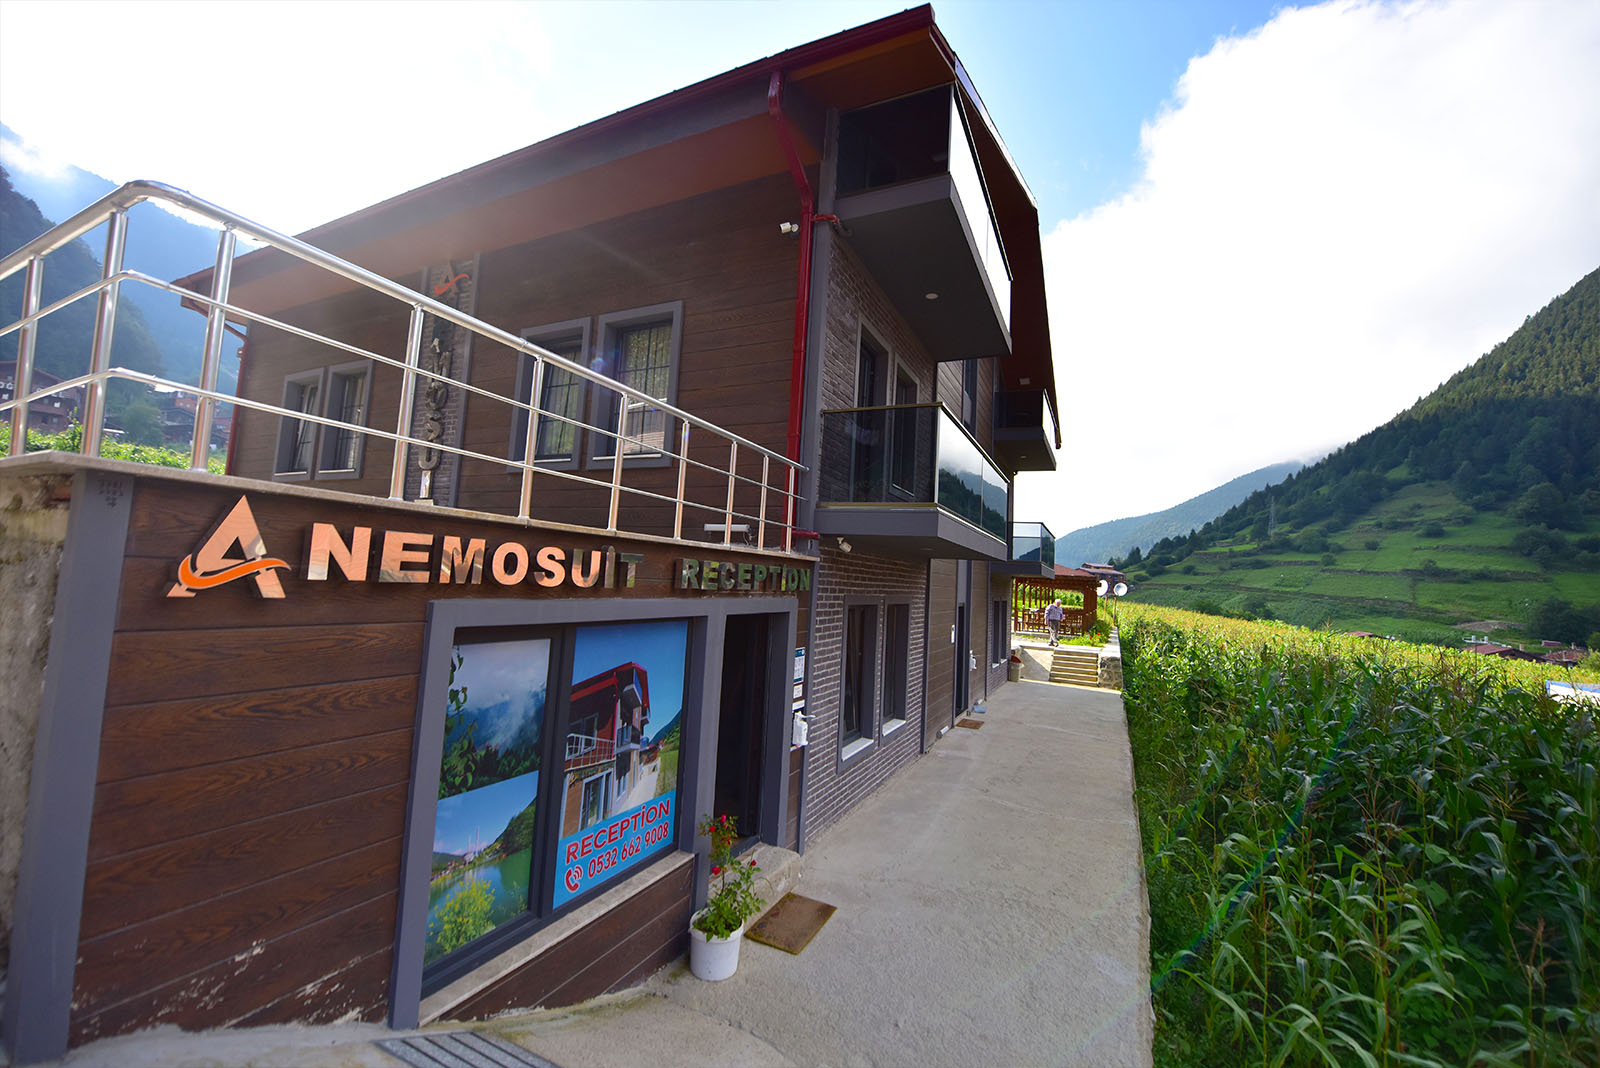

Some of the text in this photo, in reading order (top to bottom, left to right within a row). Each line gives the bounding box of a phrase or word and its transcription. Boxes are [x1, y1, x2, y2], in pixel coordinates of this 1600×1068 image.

[588, 821, 669, 879] 0532 662 9008
